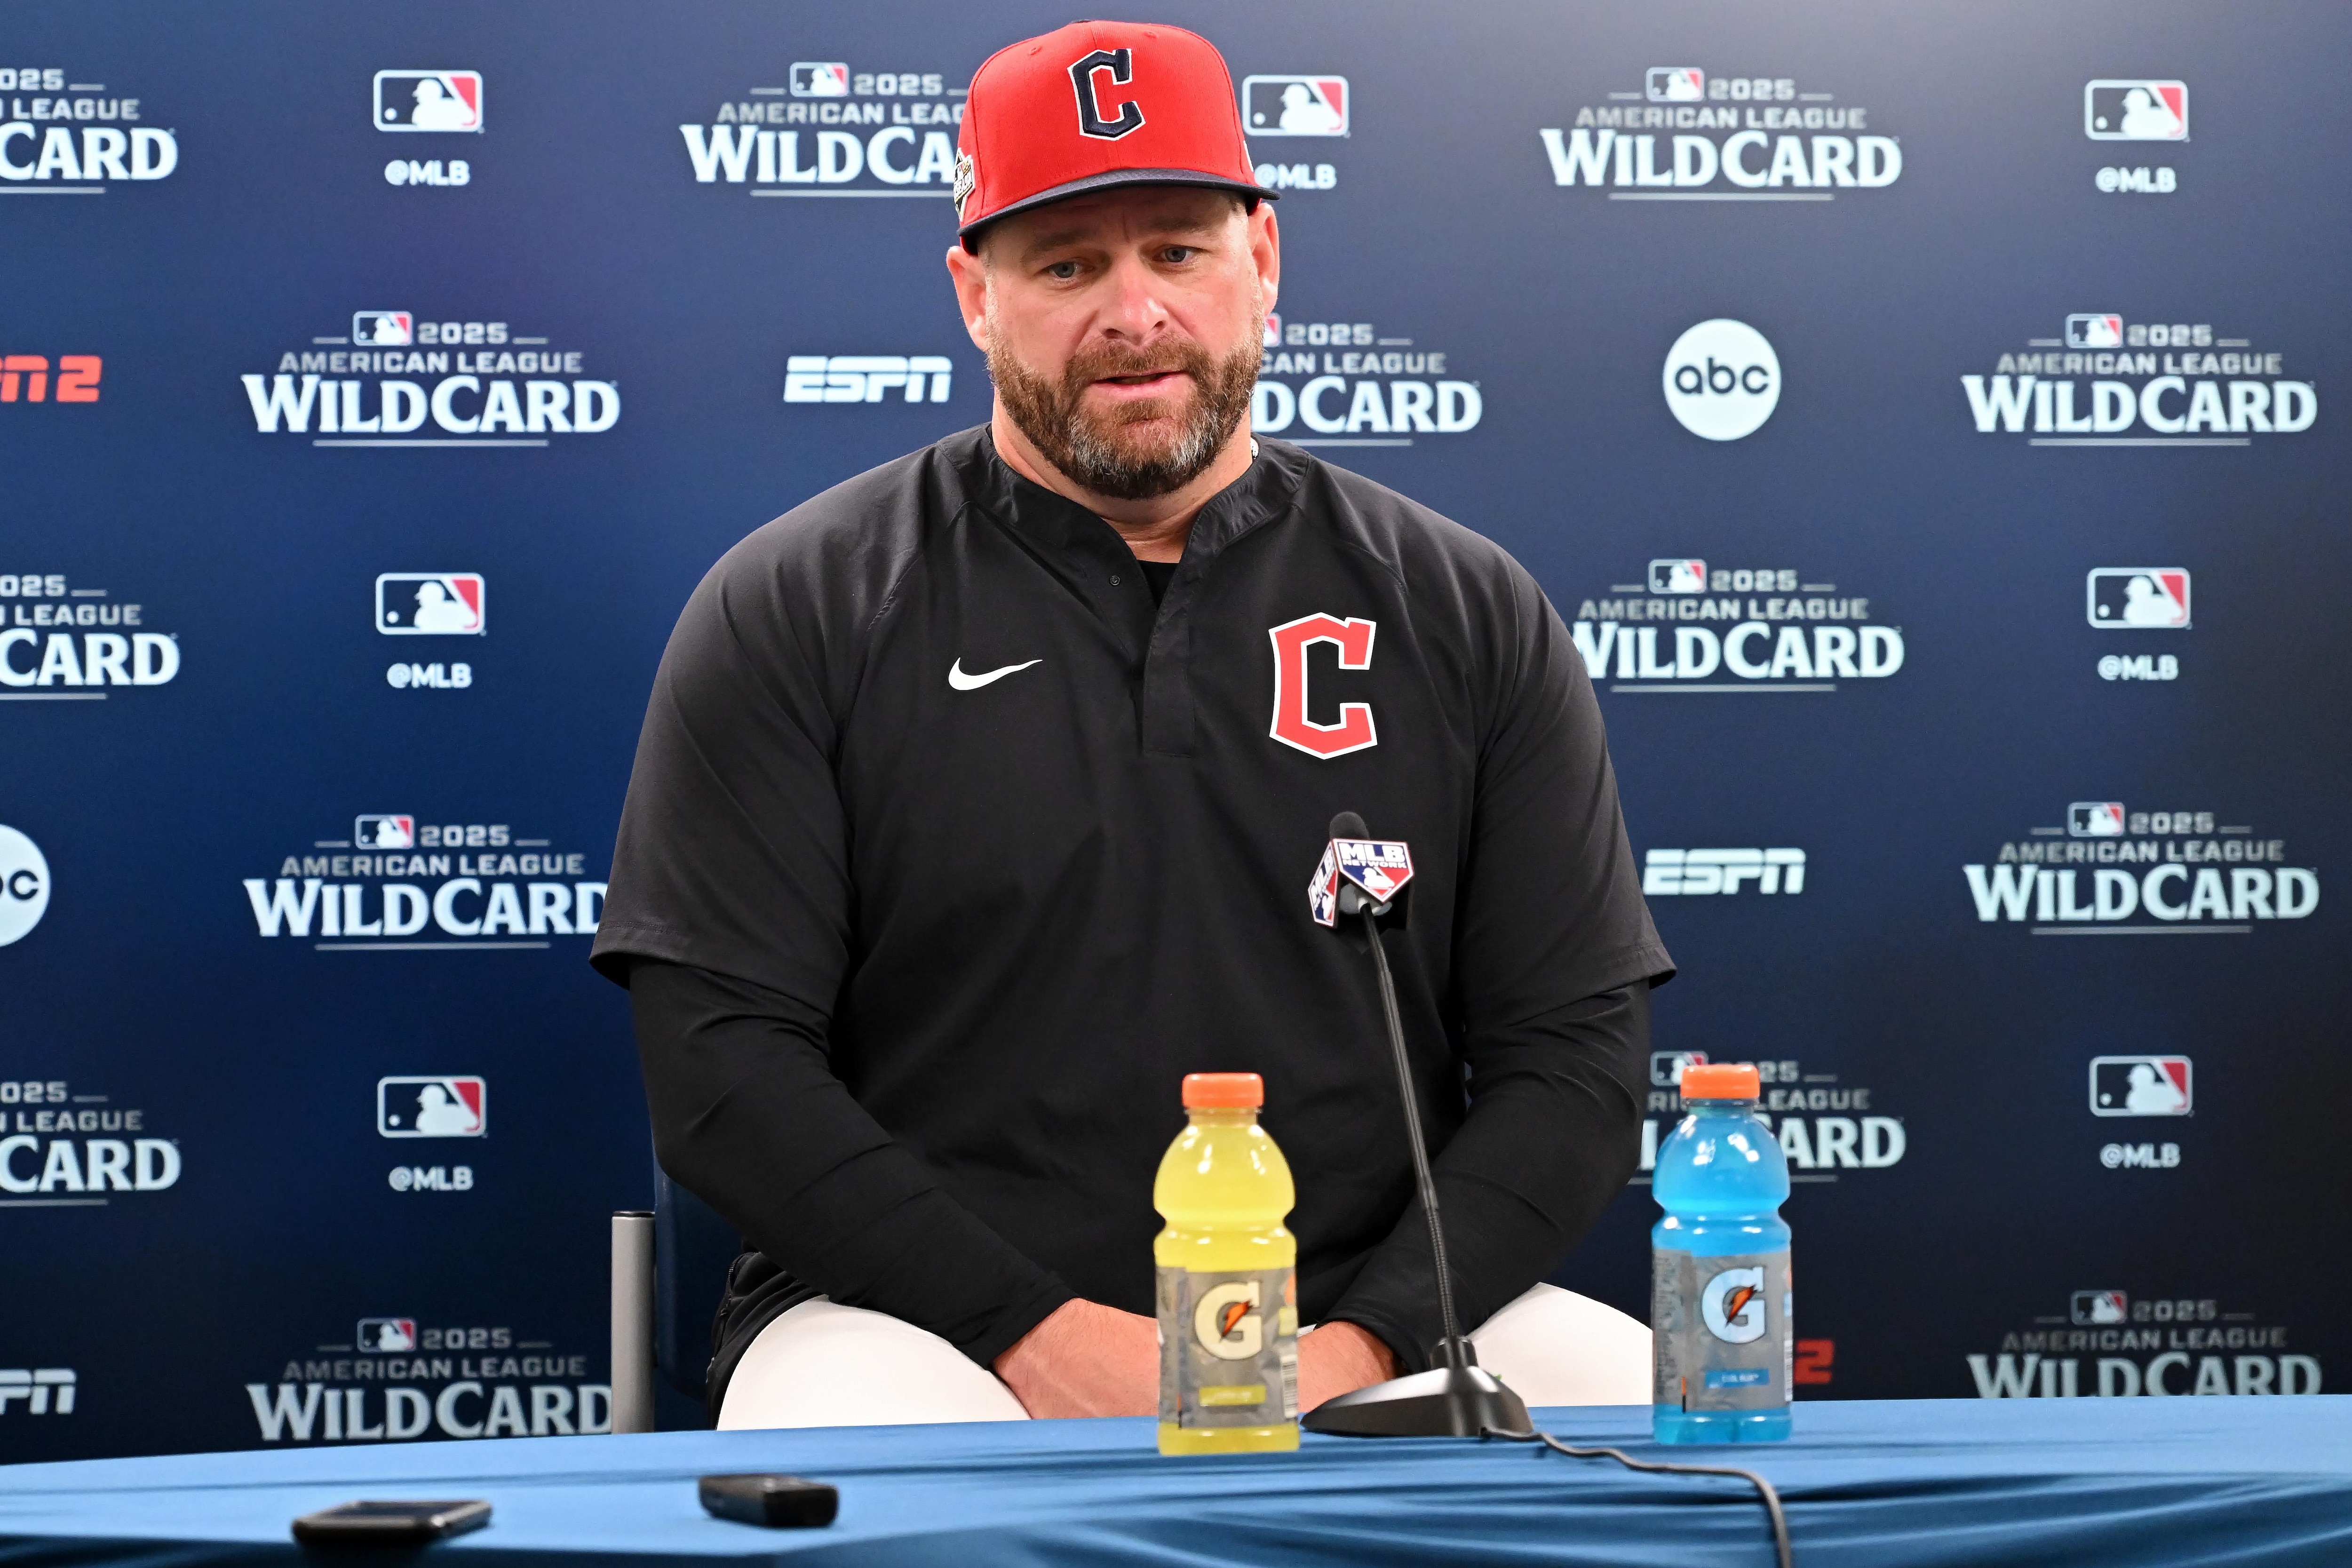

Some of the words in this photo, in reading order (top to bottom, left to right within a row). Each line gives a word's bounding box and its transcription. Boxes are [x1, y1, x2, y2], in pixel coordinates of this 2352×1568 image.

[854, 74, 942, 96] 2025
[1068, 48, 1146, 141] C
[1709, 79, 1794, 100] 2025
[13, 98, 138, 119] LEAGUE
[718, 103, 884, 124] AMERICAN
[1576, 107, 1738, 128] AMERICAN
[1745, 108, 1867, 129] LEAGUE
[680, 121, 955, 185] WILDCA
[385, 160, 470, 185] @MLB
[1254, 163, 1337, 190] @MLB
[2096, 167, 2176, 192] @MLB
[419, 323, 507, 344] 2025
[1287, 324, 1373, 345] 2025
[2128, 325, 2211, 346] 2025
[280, 352, 448, 373] AMERICAN
[458, 352, 581, 373] LEAGUE
[1324, 353, 1444, 374] LEAGUE
[1998, 353, 2156, 374] AMERICAN
[2164, 353, 2280, 374] LEAGUE
[784, 356, 952, 402] ESPN
[1675, 357, 1768, 395] abc
[1251, 375, 1483, 432] DCARD
[1712, 570, 1796, 591] 2025
[15, 605, 140, 625] LEAGUE
[1580, 599, 1740, 620] AMERICAN
[1748, 599, 1867, 620] LEAGUE
[387, 663, 472, 688] @MLB
[2098, 655, 2178, 680] @MLB
[1268, 612, 1378, 760] C
[2130, 812, 2213, 834] 2025
[421, 825, 509, 846] 2025
[1339, 843, 1406, 862] MLB
[2000, 842, 2158, 862] AMERICAN
[2166, 841, 2281, 862] LEAGUE
[282, 855, 450, 876] AMERICAN
[460, 854, 582, 875] LEAGUE
[1643, 848, 1805, 895] ESPN
[1757, 1061, 1800, 1082] 25
[17, 1111, 140, 1132] LEAGUE
[2100, 1143, 2180, 1168] @MLB
[389, 1166, 473, 1191] @MLB
[1702, 1266, 1765, 1344] G
[2134, 1300, 2215, 1321] 2025
[1195, 1281, 1263, 1361] G
[423, 1329, 510, 1349] 2025
[2002, 1329, 2161, 1351] AMERICAN
[2169, 1328, 2284, 1349] LEAGUE
[284, 1358, 452, 1379] AMERICAN
[461, 1357, 584, 1377] LEAGUE
